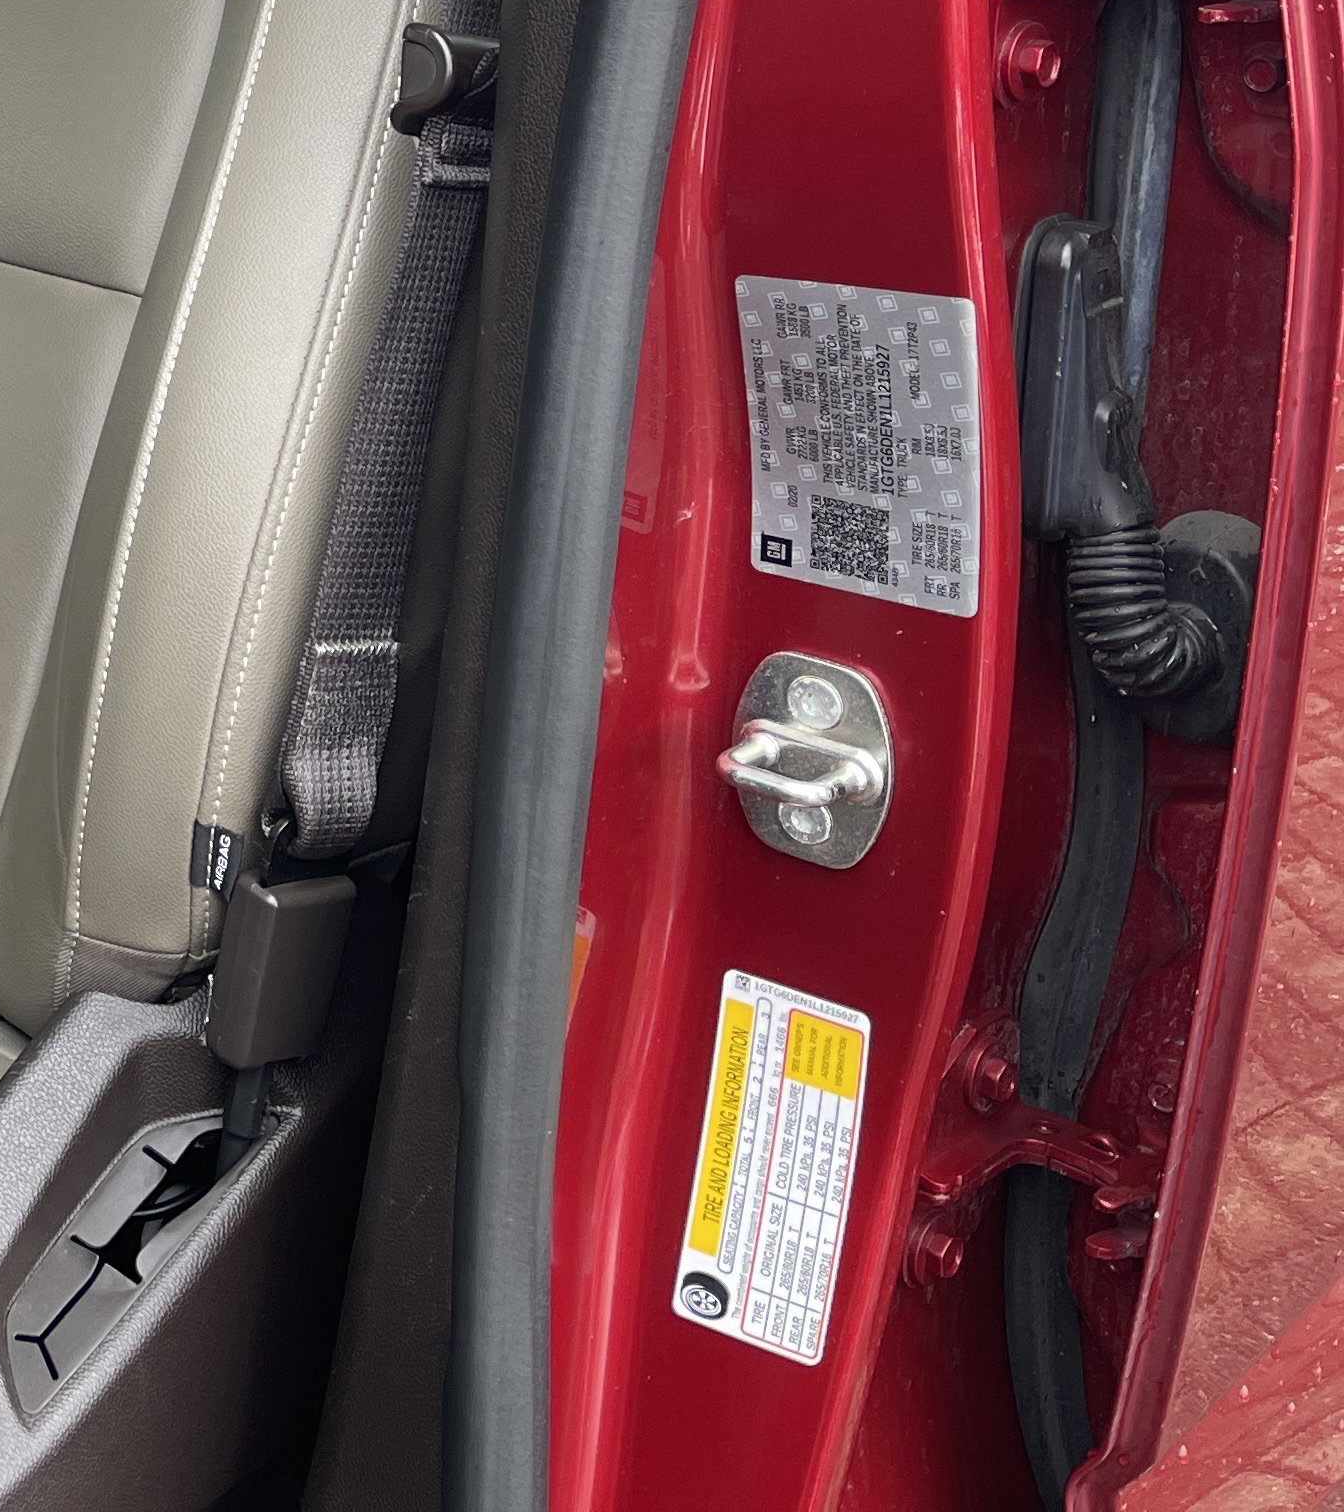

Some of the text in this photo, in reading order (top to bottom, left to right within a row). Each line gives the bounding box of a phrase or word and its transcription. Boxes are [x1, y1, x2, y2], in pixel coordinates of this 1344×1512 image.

[774, 297, 787, 339] GAWR RR
[786, 302, 796, 316] KG
[799, 305, 809, 317] LB
[827, 334, 838, 367] MOTOR
[780, 359, 793, 405] GAWR FRT
[792, 368, 802, 381] KG
[804, 371, 814, 383] LB
[830, 368, 841, 409] FEDERAL
[751, 338, 771, 472] MFD BY GENERAL MOTORS LLC
[837, 304, 856, 489] VEHICLE SAFETY AND THEFT PREVENTION
[850, 313, 868, 492] STANDARDS IN EFFECT ON THE DATE OF
[866, 389, 877, 423] SHOWN
[816, 339, 833, 484] THIS VEHICLE CONFORMS TO ALL
[877, 344, 894, 495] 1GTG6DEN1L1215927
[786, 427, 796, 455] GVWR
[797, 426, 806, 438] KG
[809, 429, 818, 441] LB
[832, 430, 844, 486] APPLICABLE
[867, 425, 879, 494] MANUFACTURE
[896, 437, 907, 469] TRUCK
[912, 438, 921, 455] RIM
[787, 484, 798, 508] 02/20
[766, 540, 781, 559] GM
[912, 521, 922, 566] TIRE SIZE
[924, 576, 934, 594] FRT
[937, 583, 947, 597] RR
[949, 581, 960, 600] SPA
[213, 834, 231, 890] AIRBAG
[756, 1033, 769, 1057] REAR
[747, 1093, 760, 1121] FRONT
[703, 1026, 750, 1226] TIRE AND LOADING INFORMATION
[775, 1083, 801, 1190] COLD TIRE PRESSURE
[805, 1114, 817, 1133] PSI
[822, 1120, 835, 1139] PSI
[840, 1126, 852, 1145] PSI
[803, 1135, 815, 1149] 35
[820, 1141, 833, 1155] 35
[838, 1147, 850, 1160] 35
[738, 1149, 751, 1178] TOTAL
[796, 1173, 809, 1192] 240
[813, 1179, 827, 1198] 240
[831, 1185, 844, 1204] 240
[723, 1190, 744, 1266] SEATING CAPACITY
[760, 1202, 783, 1278] ORIGINAL SIZE
[752, 1300, 766, 1326] TIRE
[771, 1304, 785, 1339] FRONT
[789, 1315, 802, 1345] REAR
[806, 1317, 820, 1351] SPARE
